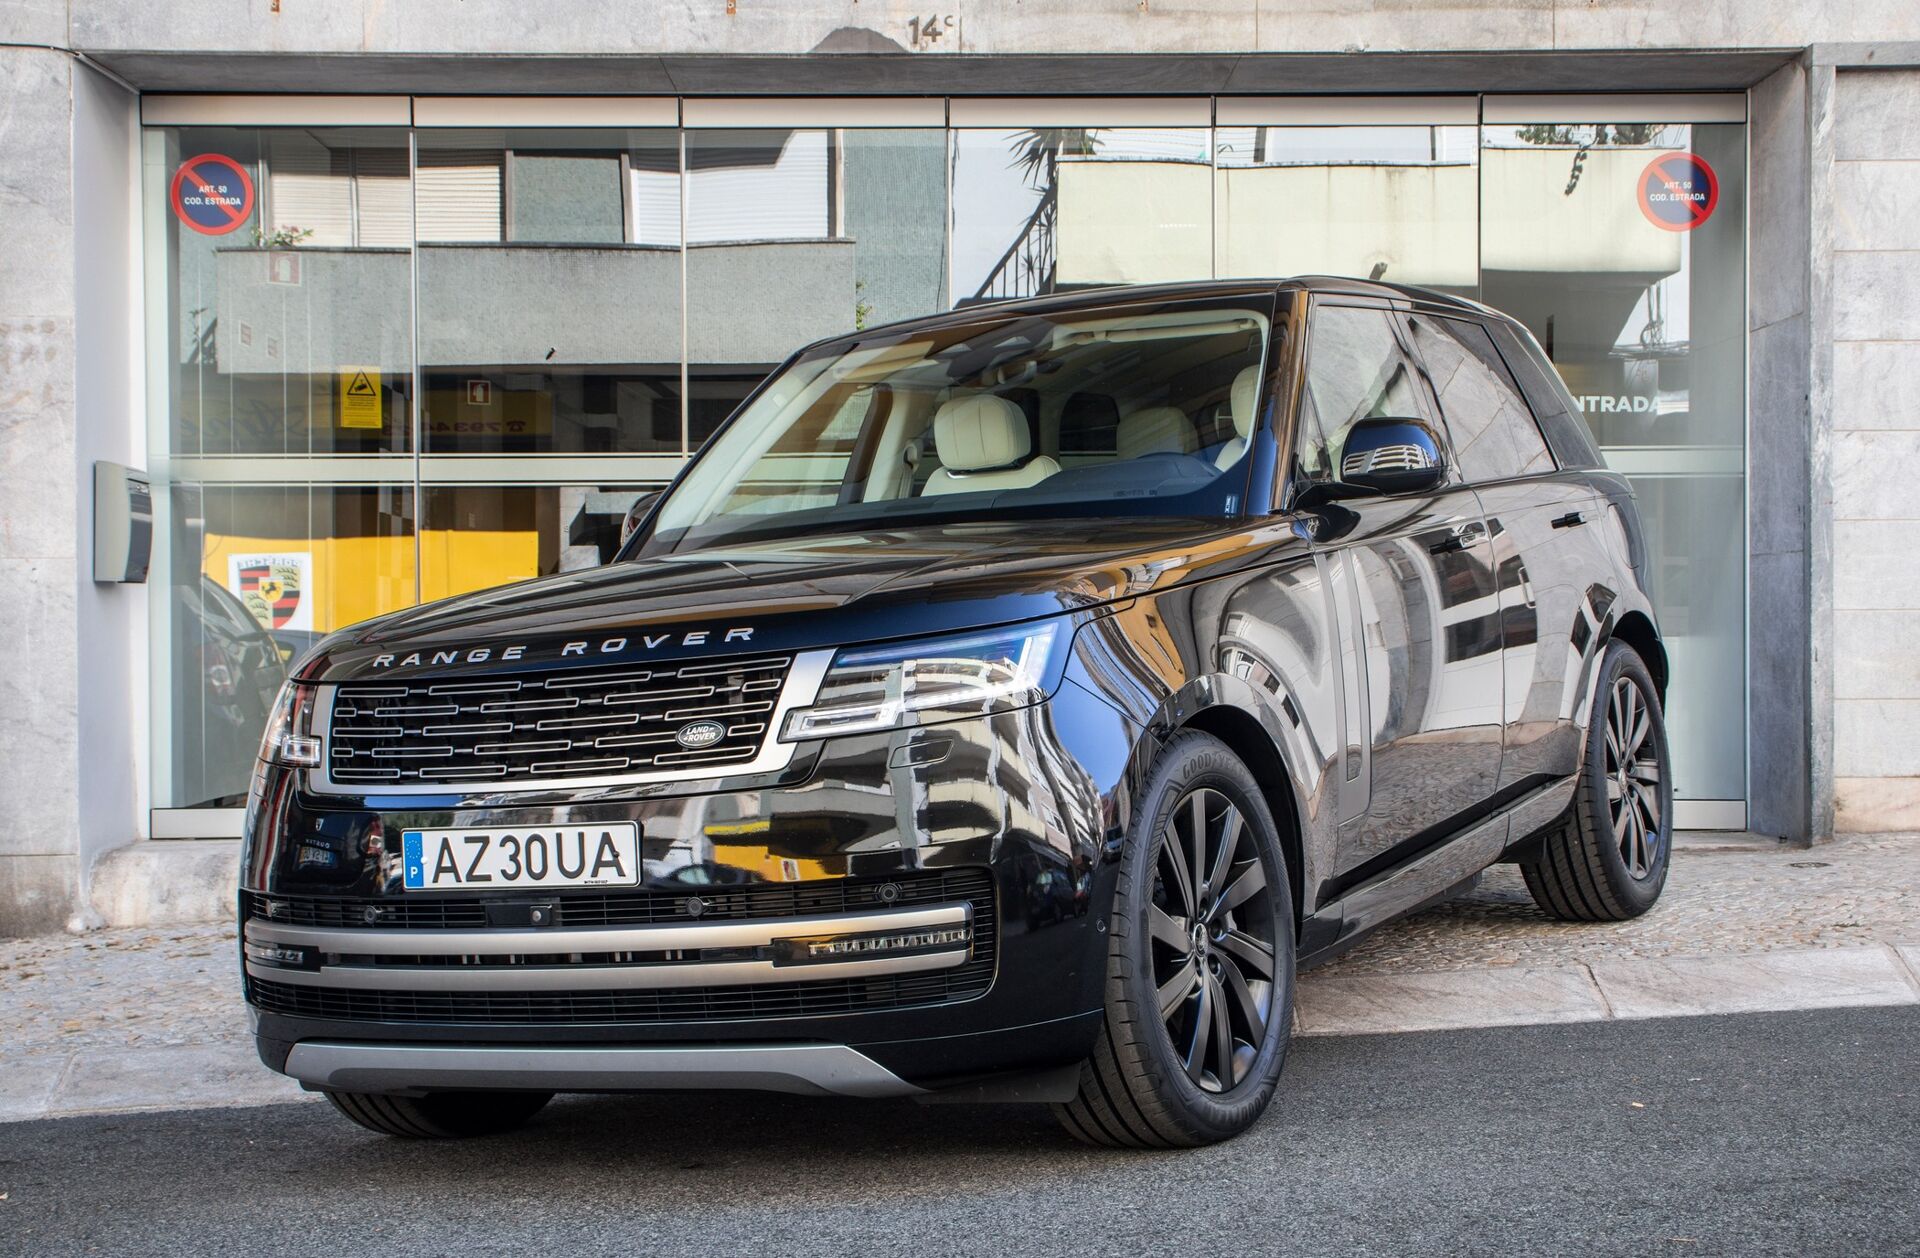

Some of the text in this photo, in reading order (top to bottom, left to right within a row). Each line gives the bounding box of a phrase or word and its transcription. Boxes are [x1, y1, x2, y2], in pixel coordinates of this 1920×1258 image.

[199, 185, 228, 193] ART. 50
[1664, 181, 1692, 189] ART. 50
[184, 197, 241, 205] COD. ESTRADA
[1670, 193, 1705, 201] ESTRADA
[372, 627, 755, 668] RANGE ROVER
[686, 725, 710, 735] LAND
[687, 732, 716, 742] ROVER
[410, 866, 418, 879] P
